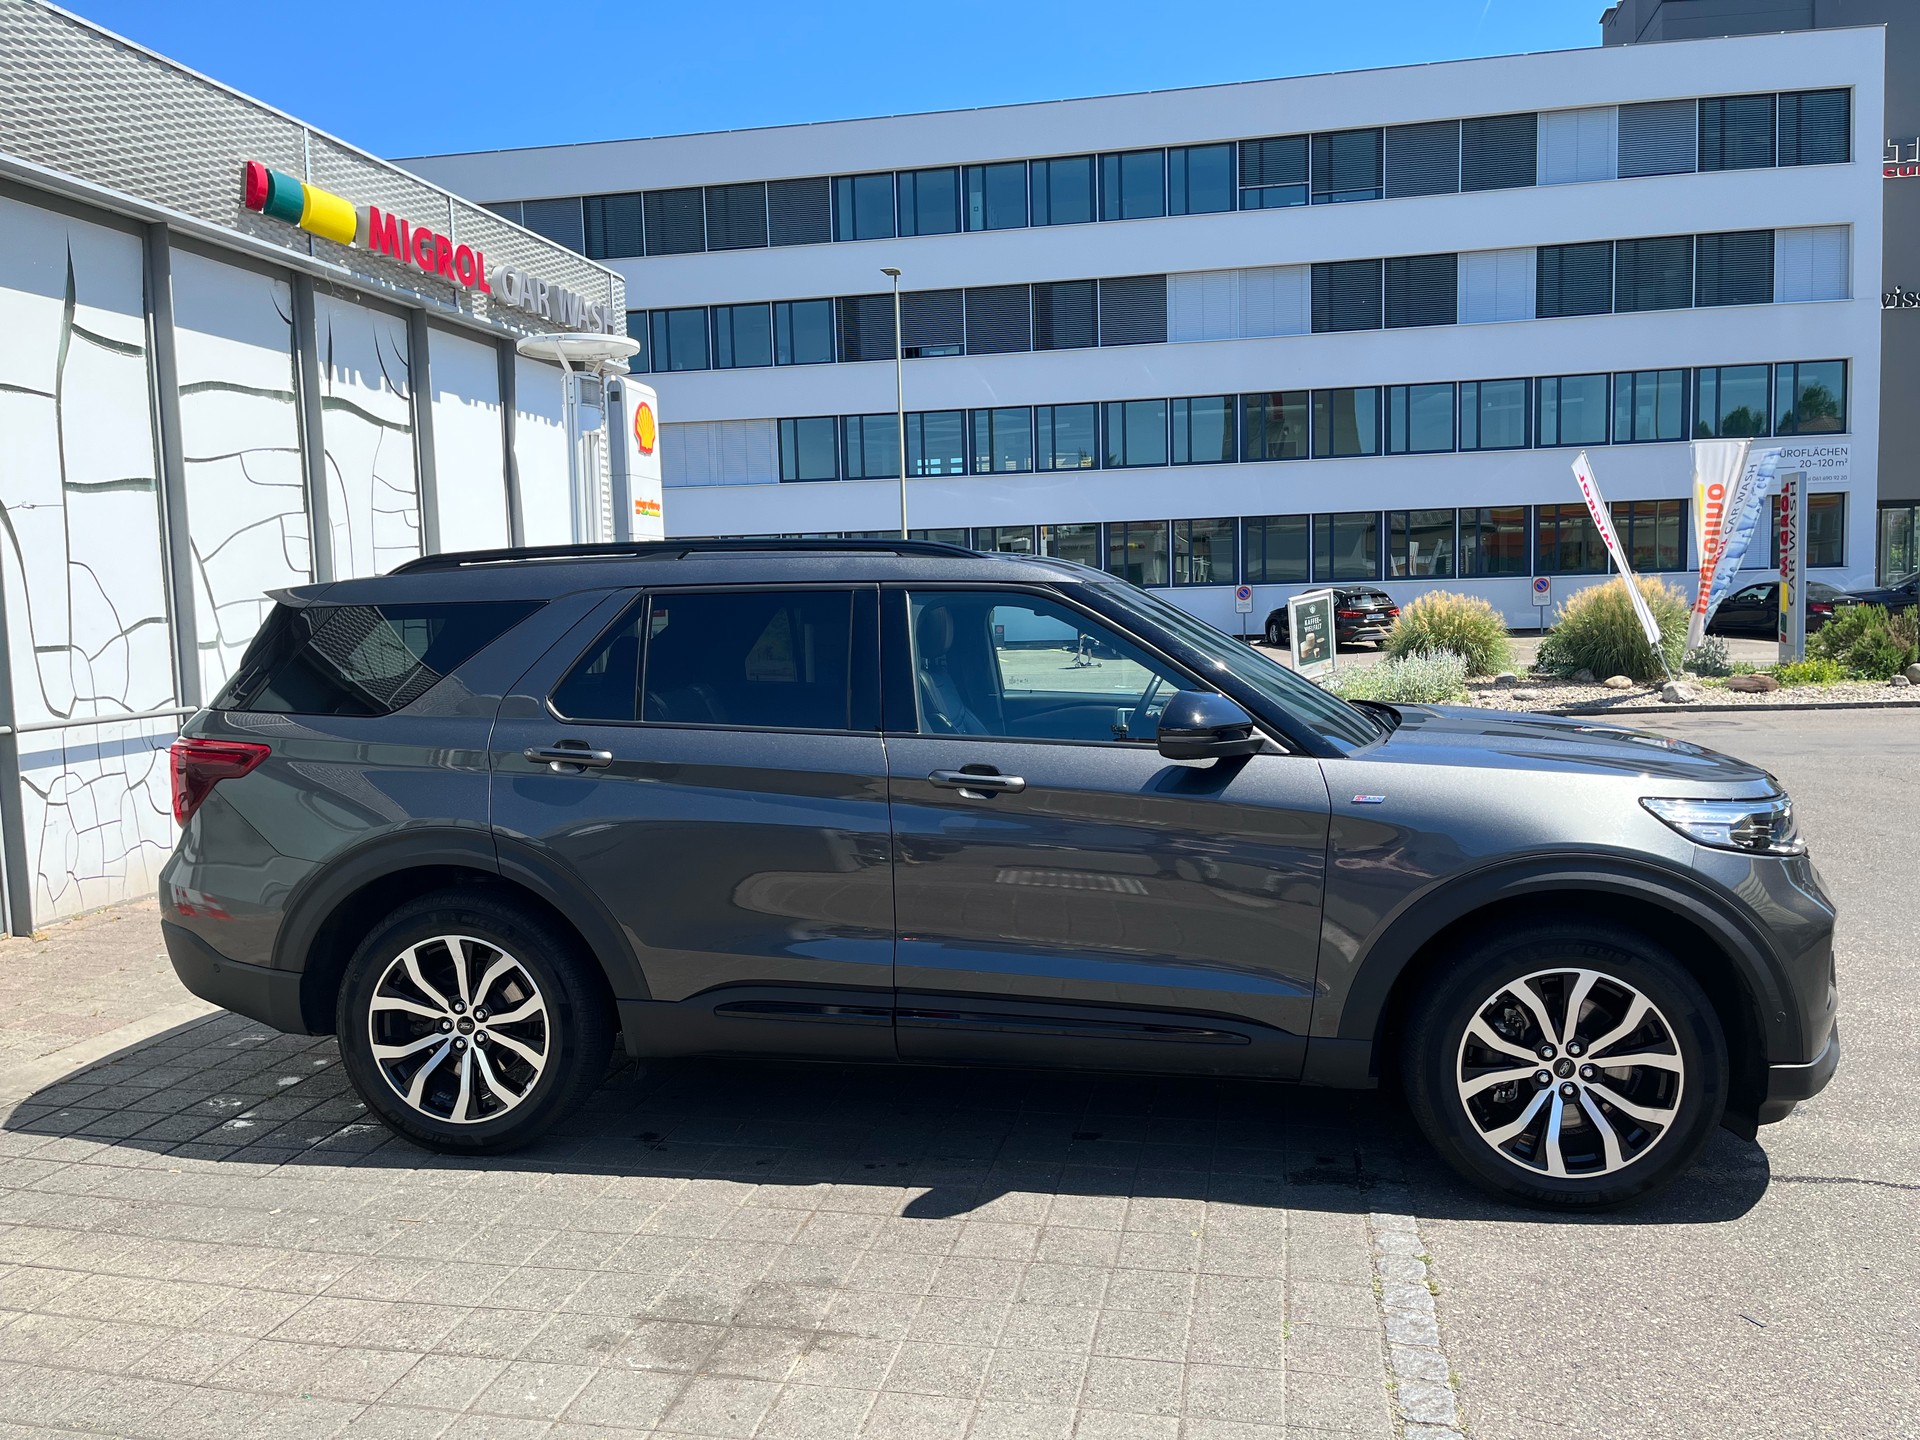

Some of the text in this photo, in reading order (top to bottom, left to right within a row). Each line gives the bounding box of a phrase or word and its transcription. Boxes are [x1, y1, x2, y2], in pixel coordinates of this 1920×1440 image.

[368, 205, 616, 334] MIGROL CAR WASH
[1725, 508, 1739, 535] CAR
[1735, 464, 1757, 505] WASH
[1780, 482, 1789, 578] MIGROL
